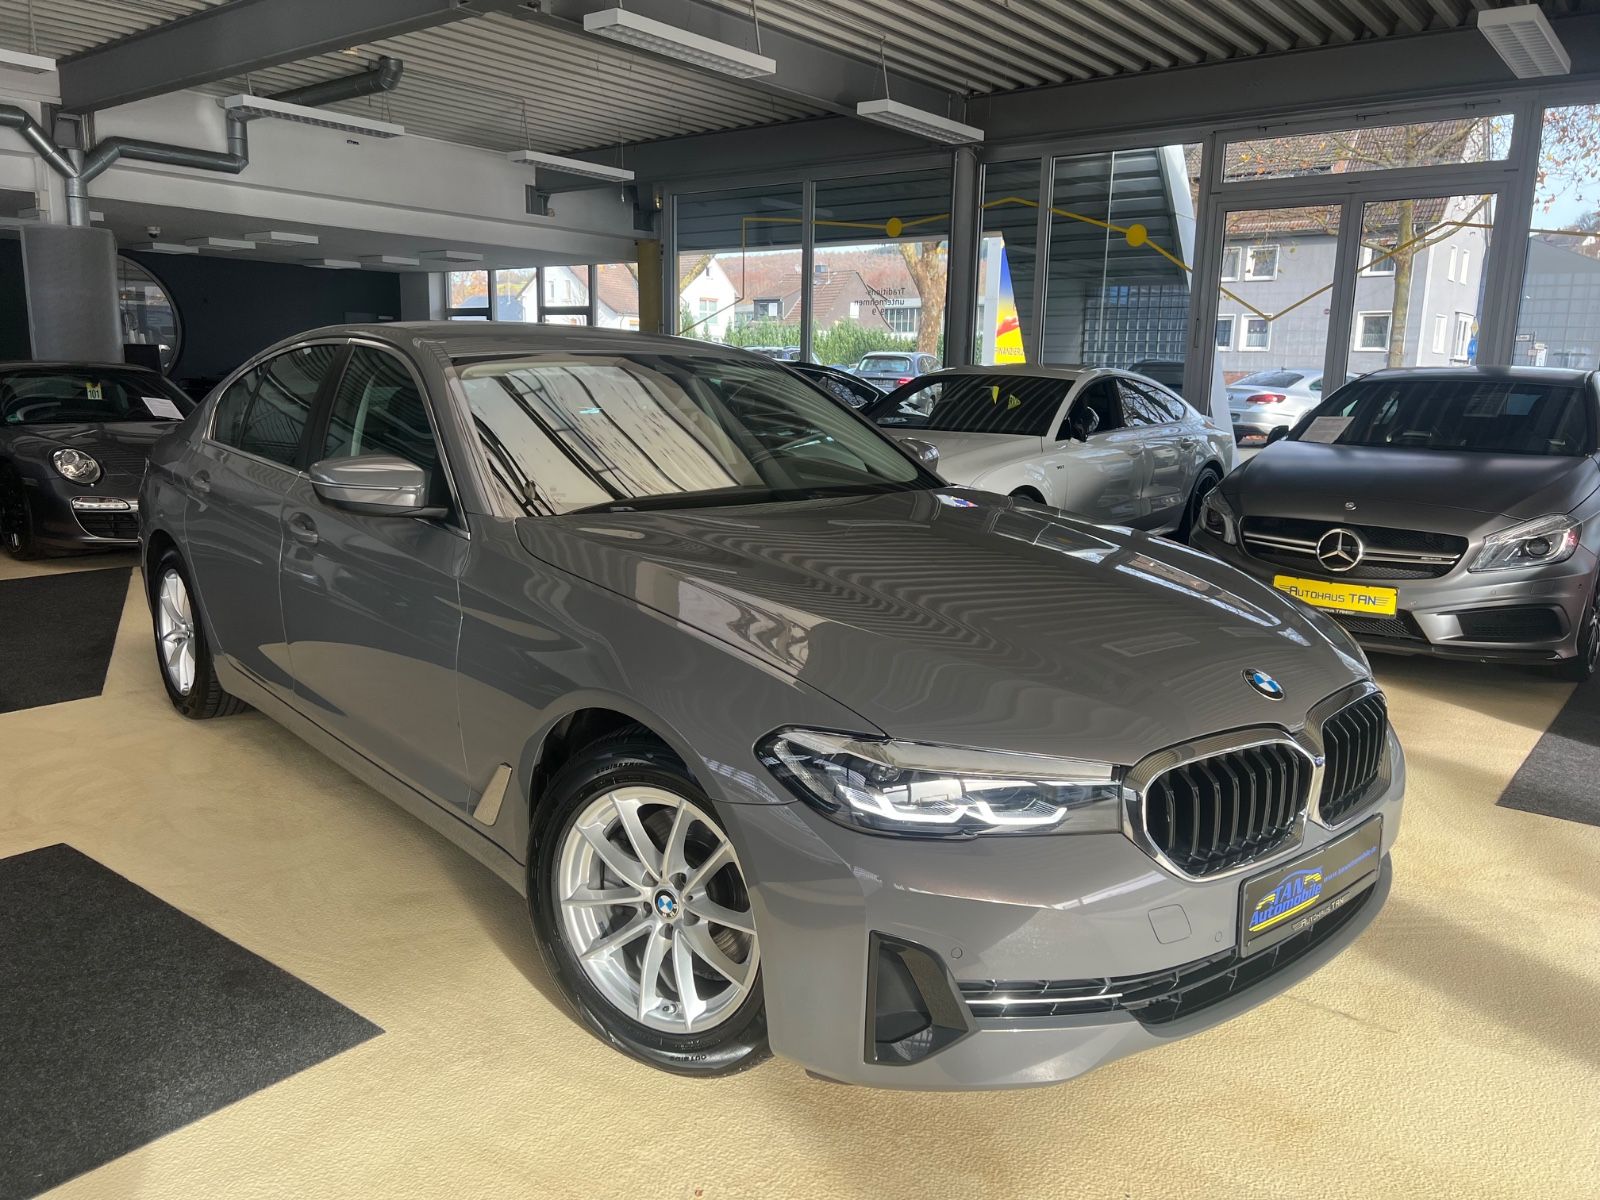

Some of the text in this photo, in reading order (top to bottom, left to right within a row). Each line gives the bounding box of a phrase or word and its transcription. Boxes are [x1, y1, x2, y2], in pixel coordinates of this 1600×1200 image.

[1289, 586, 1377, 606] AUTOHAUS TAN
[1249, 882, 1321, 928] Automobile
[1273, 877, 1304, 906] TAN
